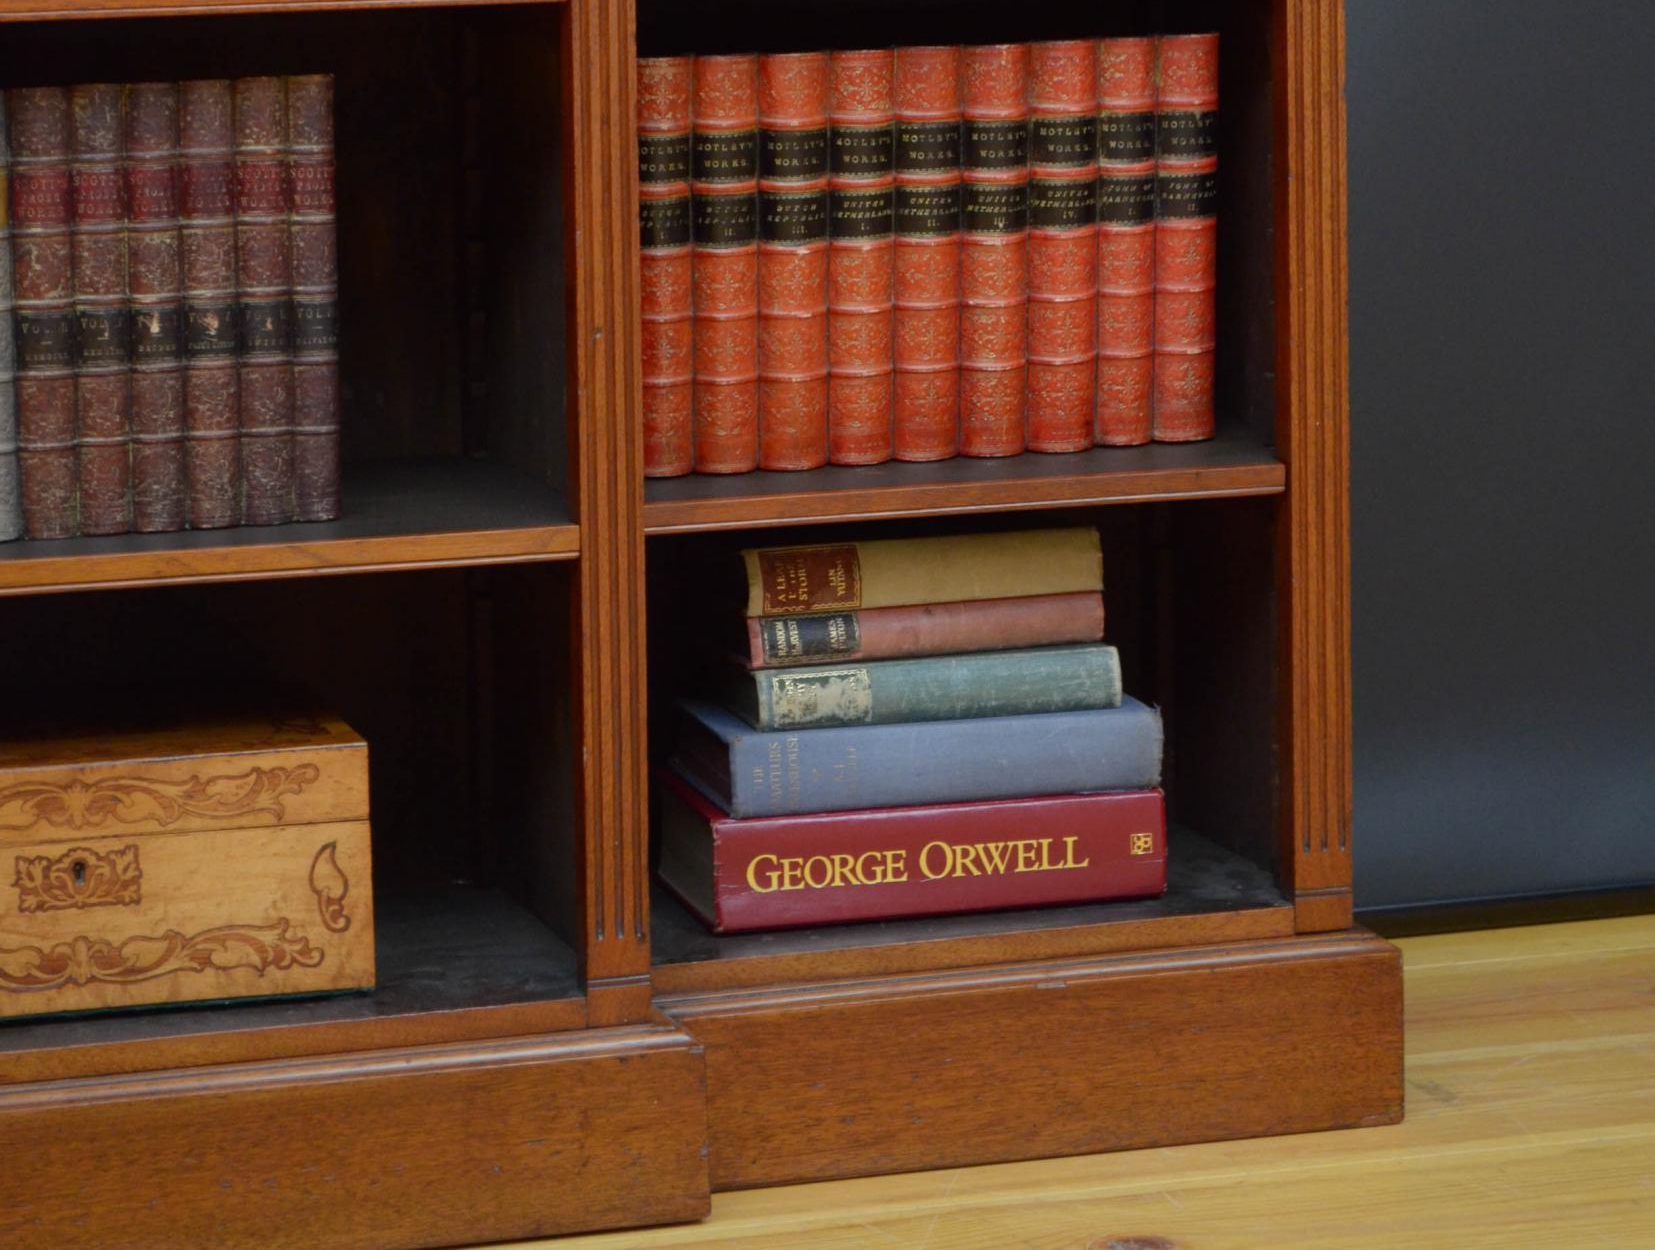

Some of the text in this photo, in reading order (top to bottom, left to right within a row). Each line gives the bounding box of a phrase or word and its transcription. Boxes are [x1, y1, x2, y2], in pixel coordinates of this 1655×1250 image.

[640, 144, 688, 155] OTLEY'S
[775, 620, 787, 656] RANDOM
[746, 850, 909, 893] GEORGE
[919, 836, 1089, 879] ORWELL
